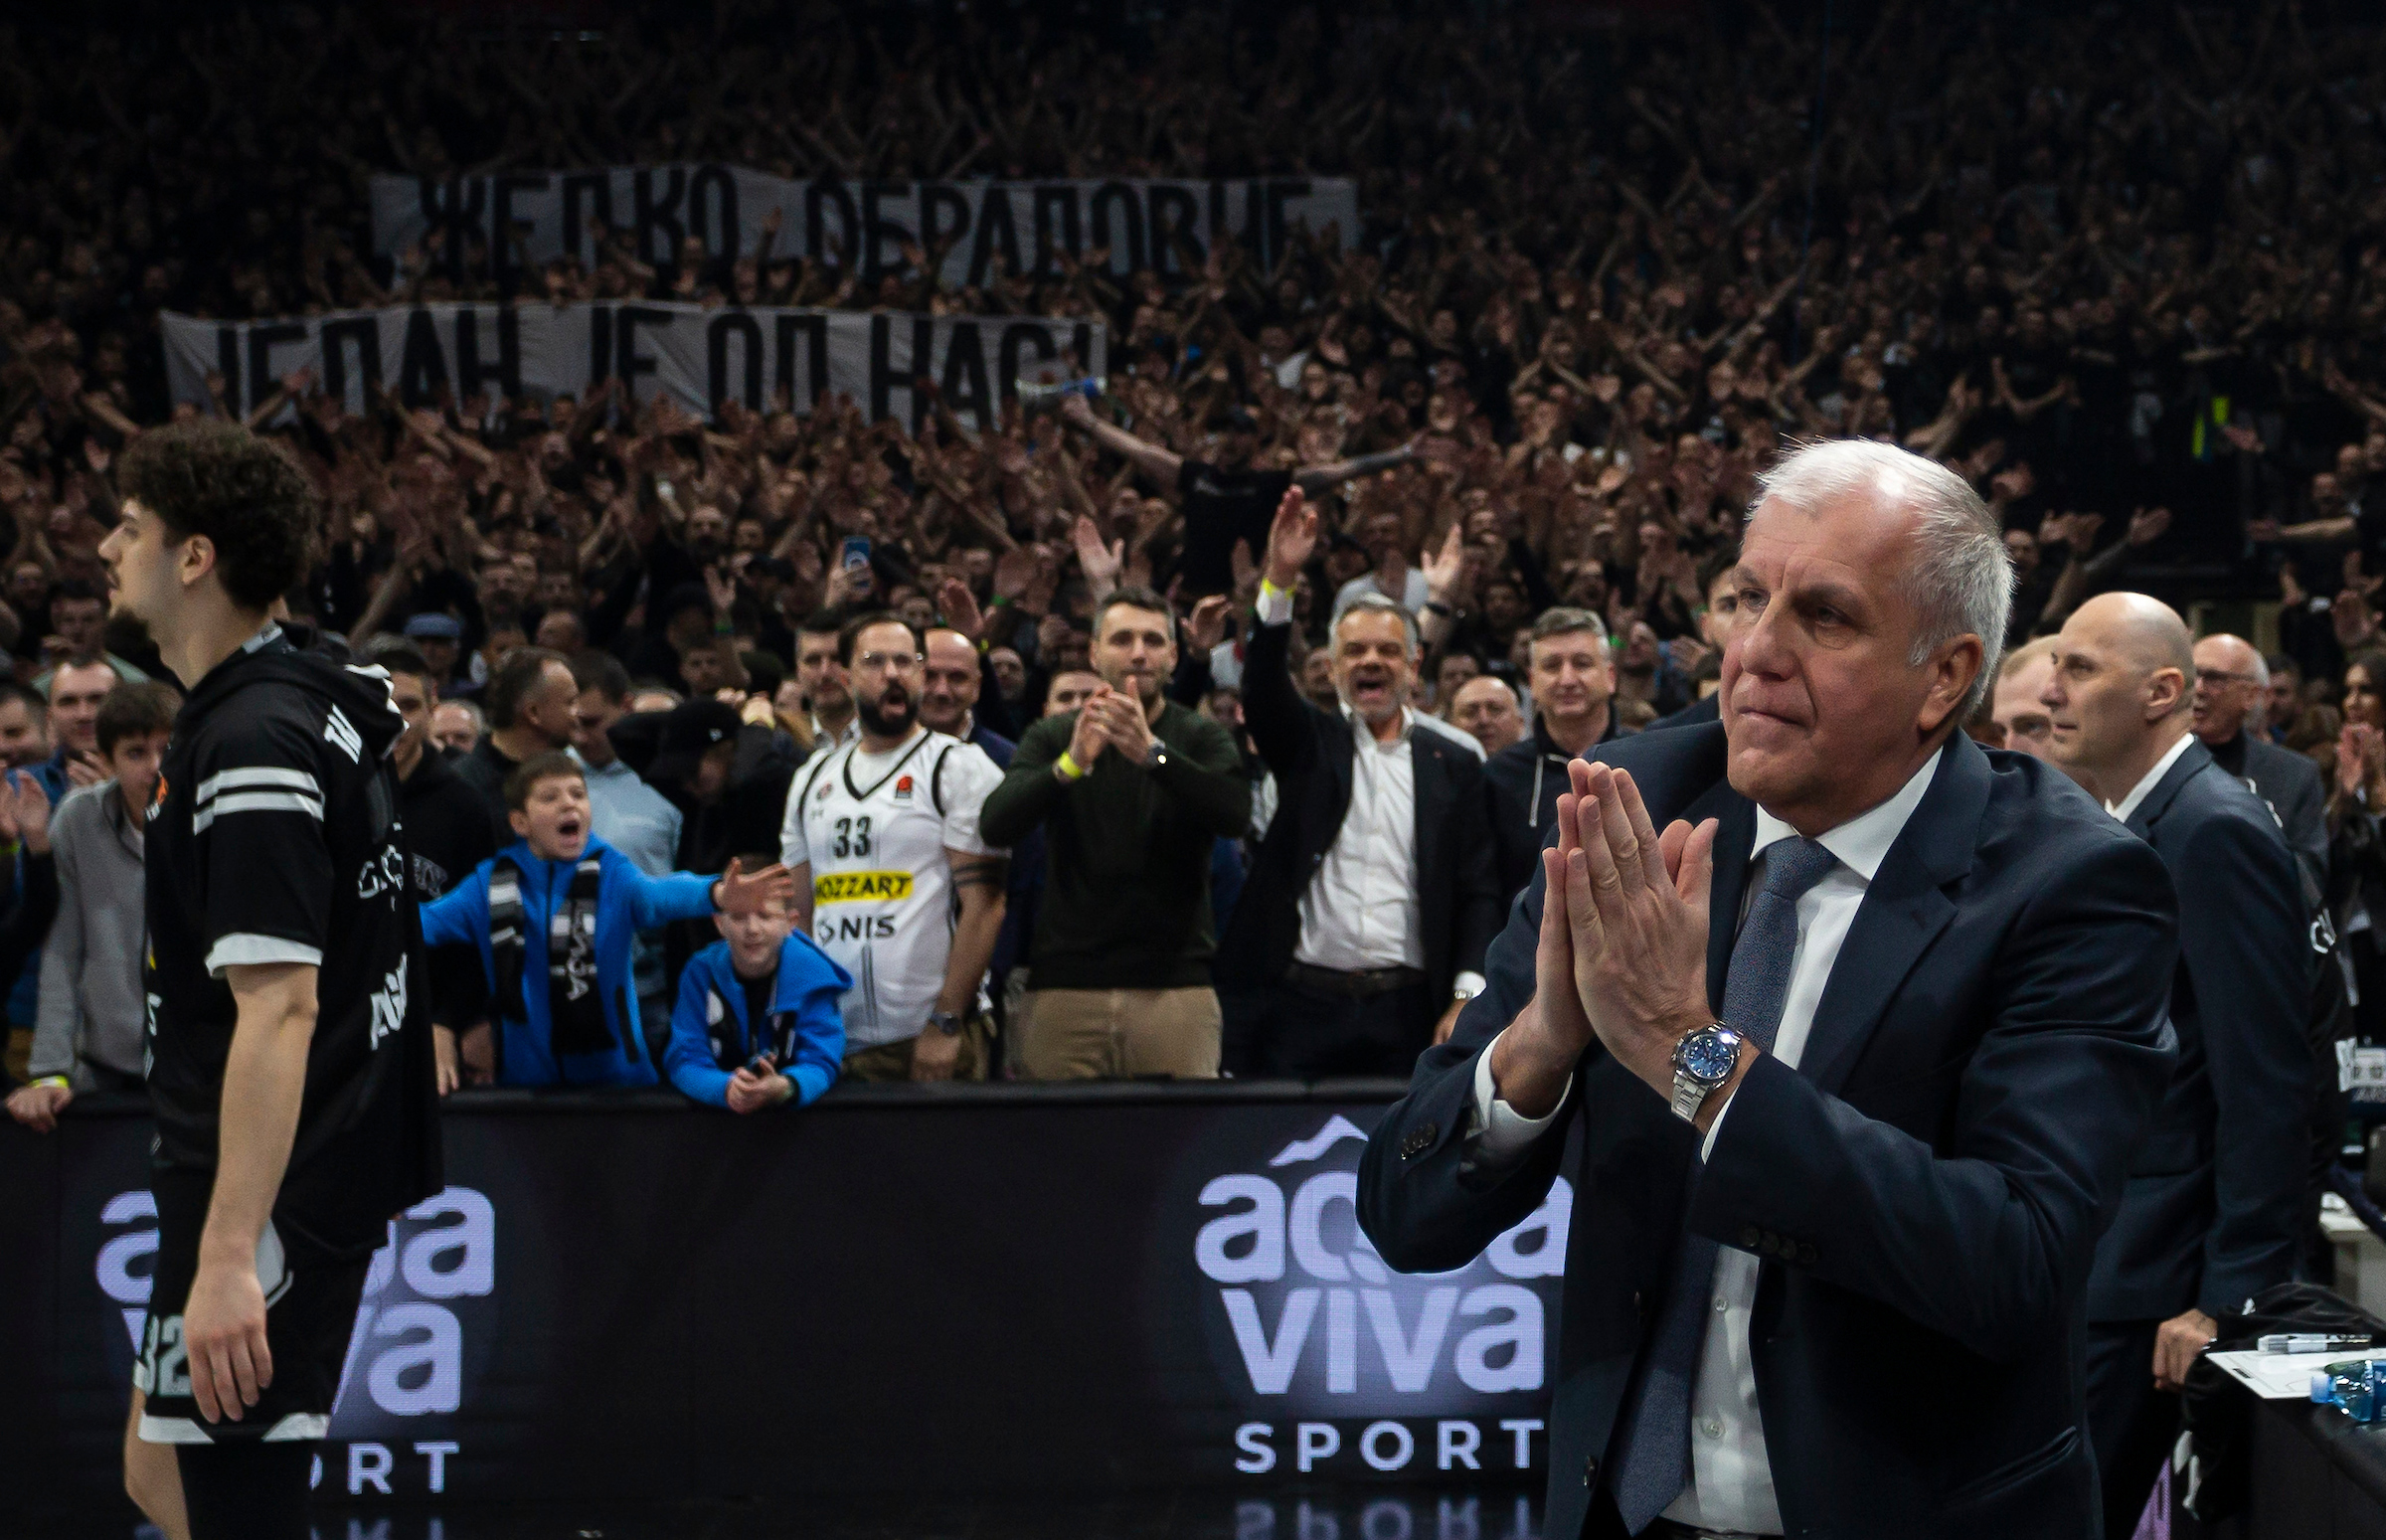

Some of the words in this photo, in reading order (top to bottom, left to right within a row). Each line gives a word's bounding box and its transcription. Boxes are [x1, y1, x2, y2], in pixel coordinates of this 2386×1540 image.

[833, 815, 872, 859] 33
[841, 915, 896, 941] NIS
[1220, 1282, 1545, 1395] viva
[1234, 1419, 1545, 1473] SPORT
